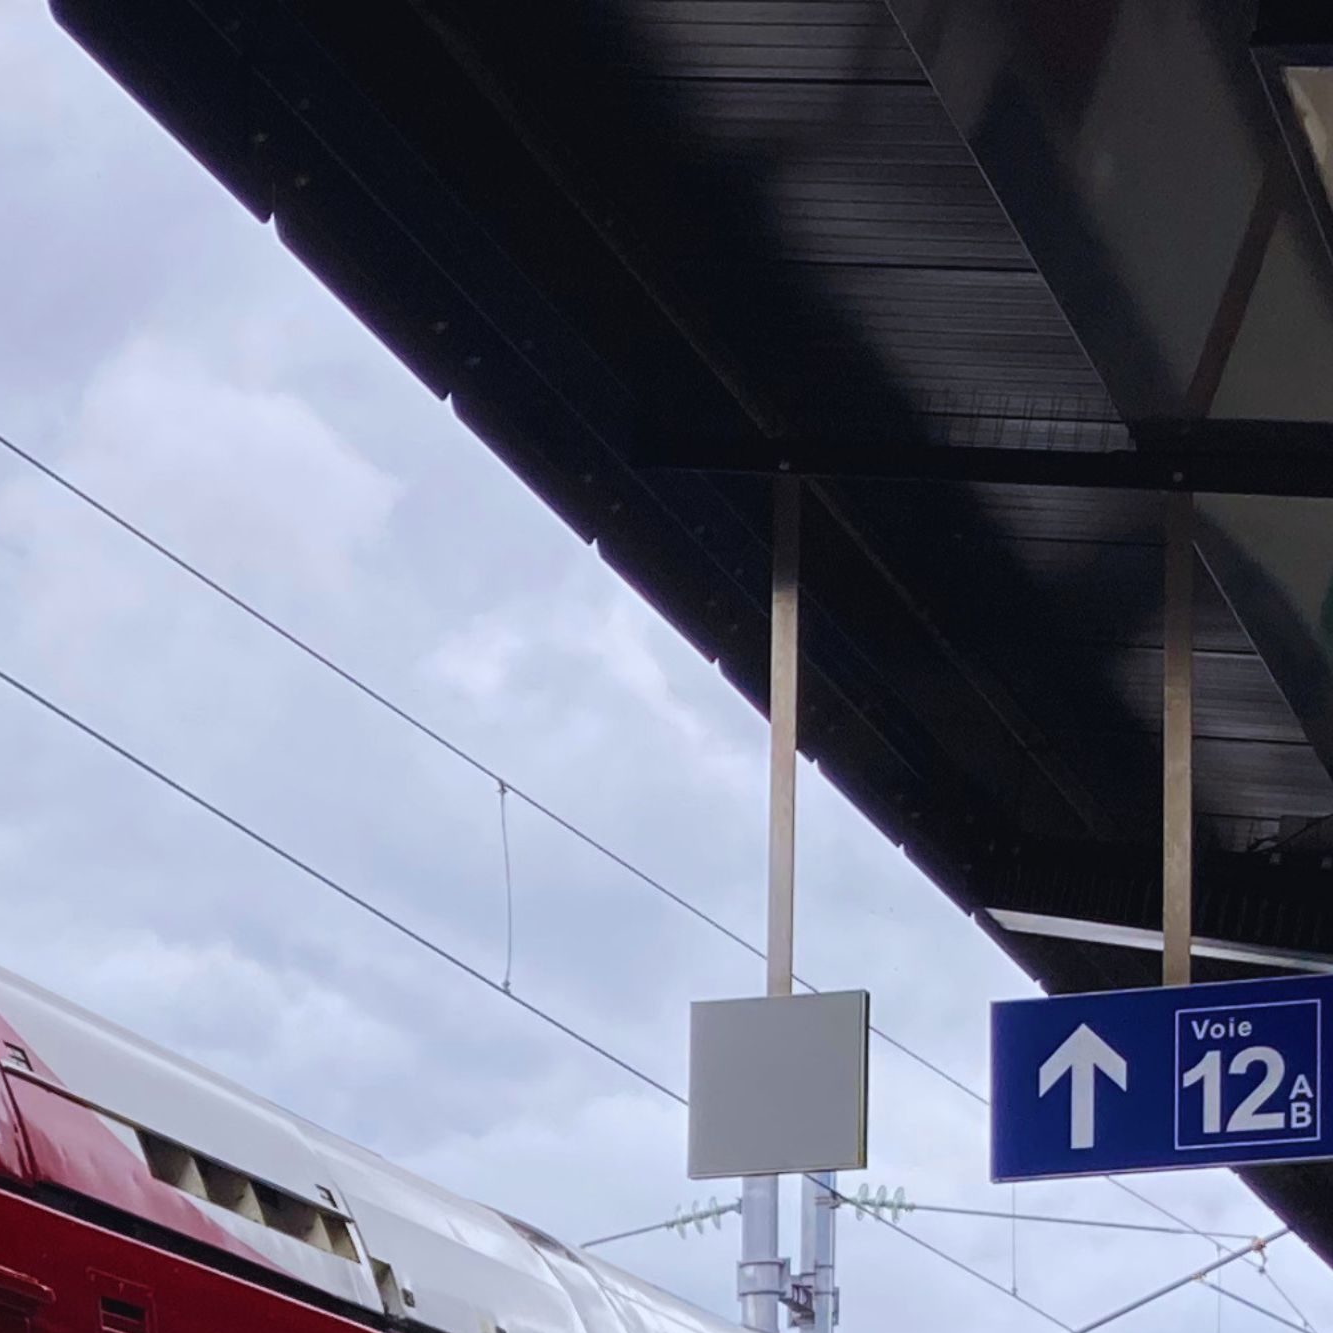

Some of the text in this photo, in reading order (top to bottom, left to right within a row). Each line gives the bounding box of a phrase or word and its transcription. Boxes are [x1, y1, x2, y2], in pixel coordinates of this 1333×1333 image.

[1192, 1017, 1252, 1040] Voie
[1182, 1045, 1286, 1135] 12
[1289, 1073, 1315, 1099] A
[1290, 1102, 1313, 1130] B
